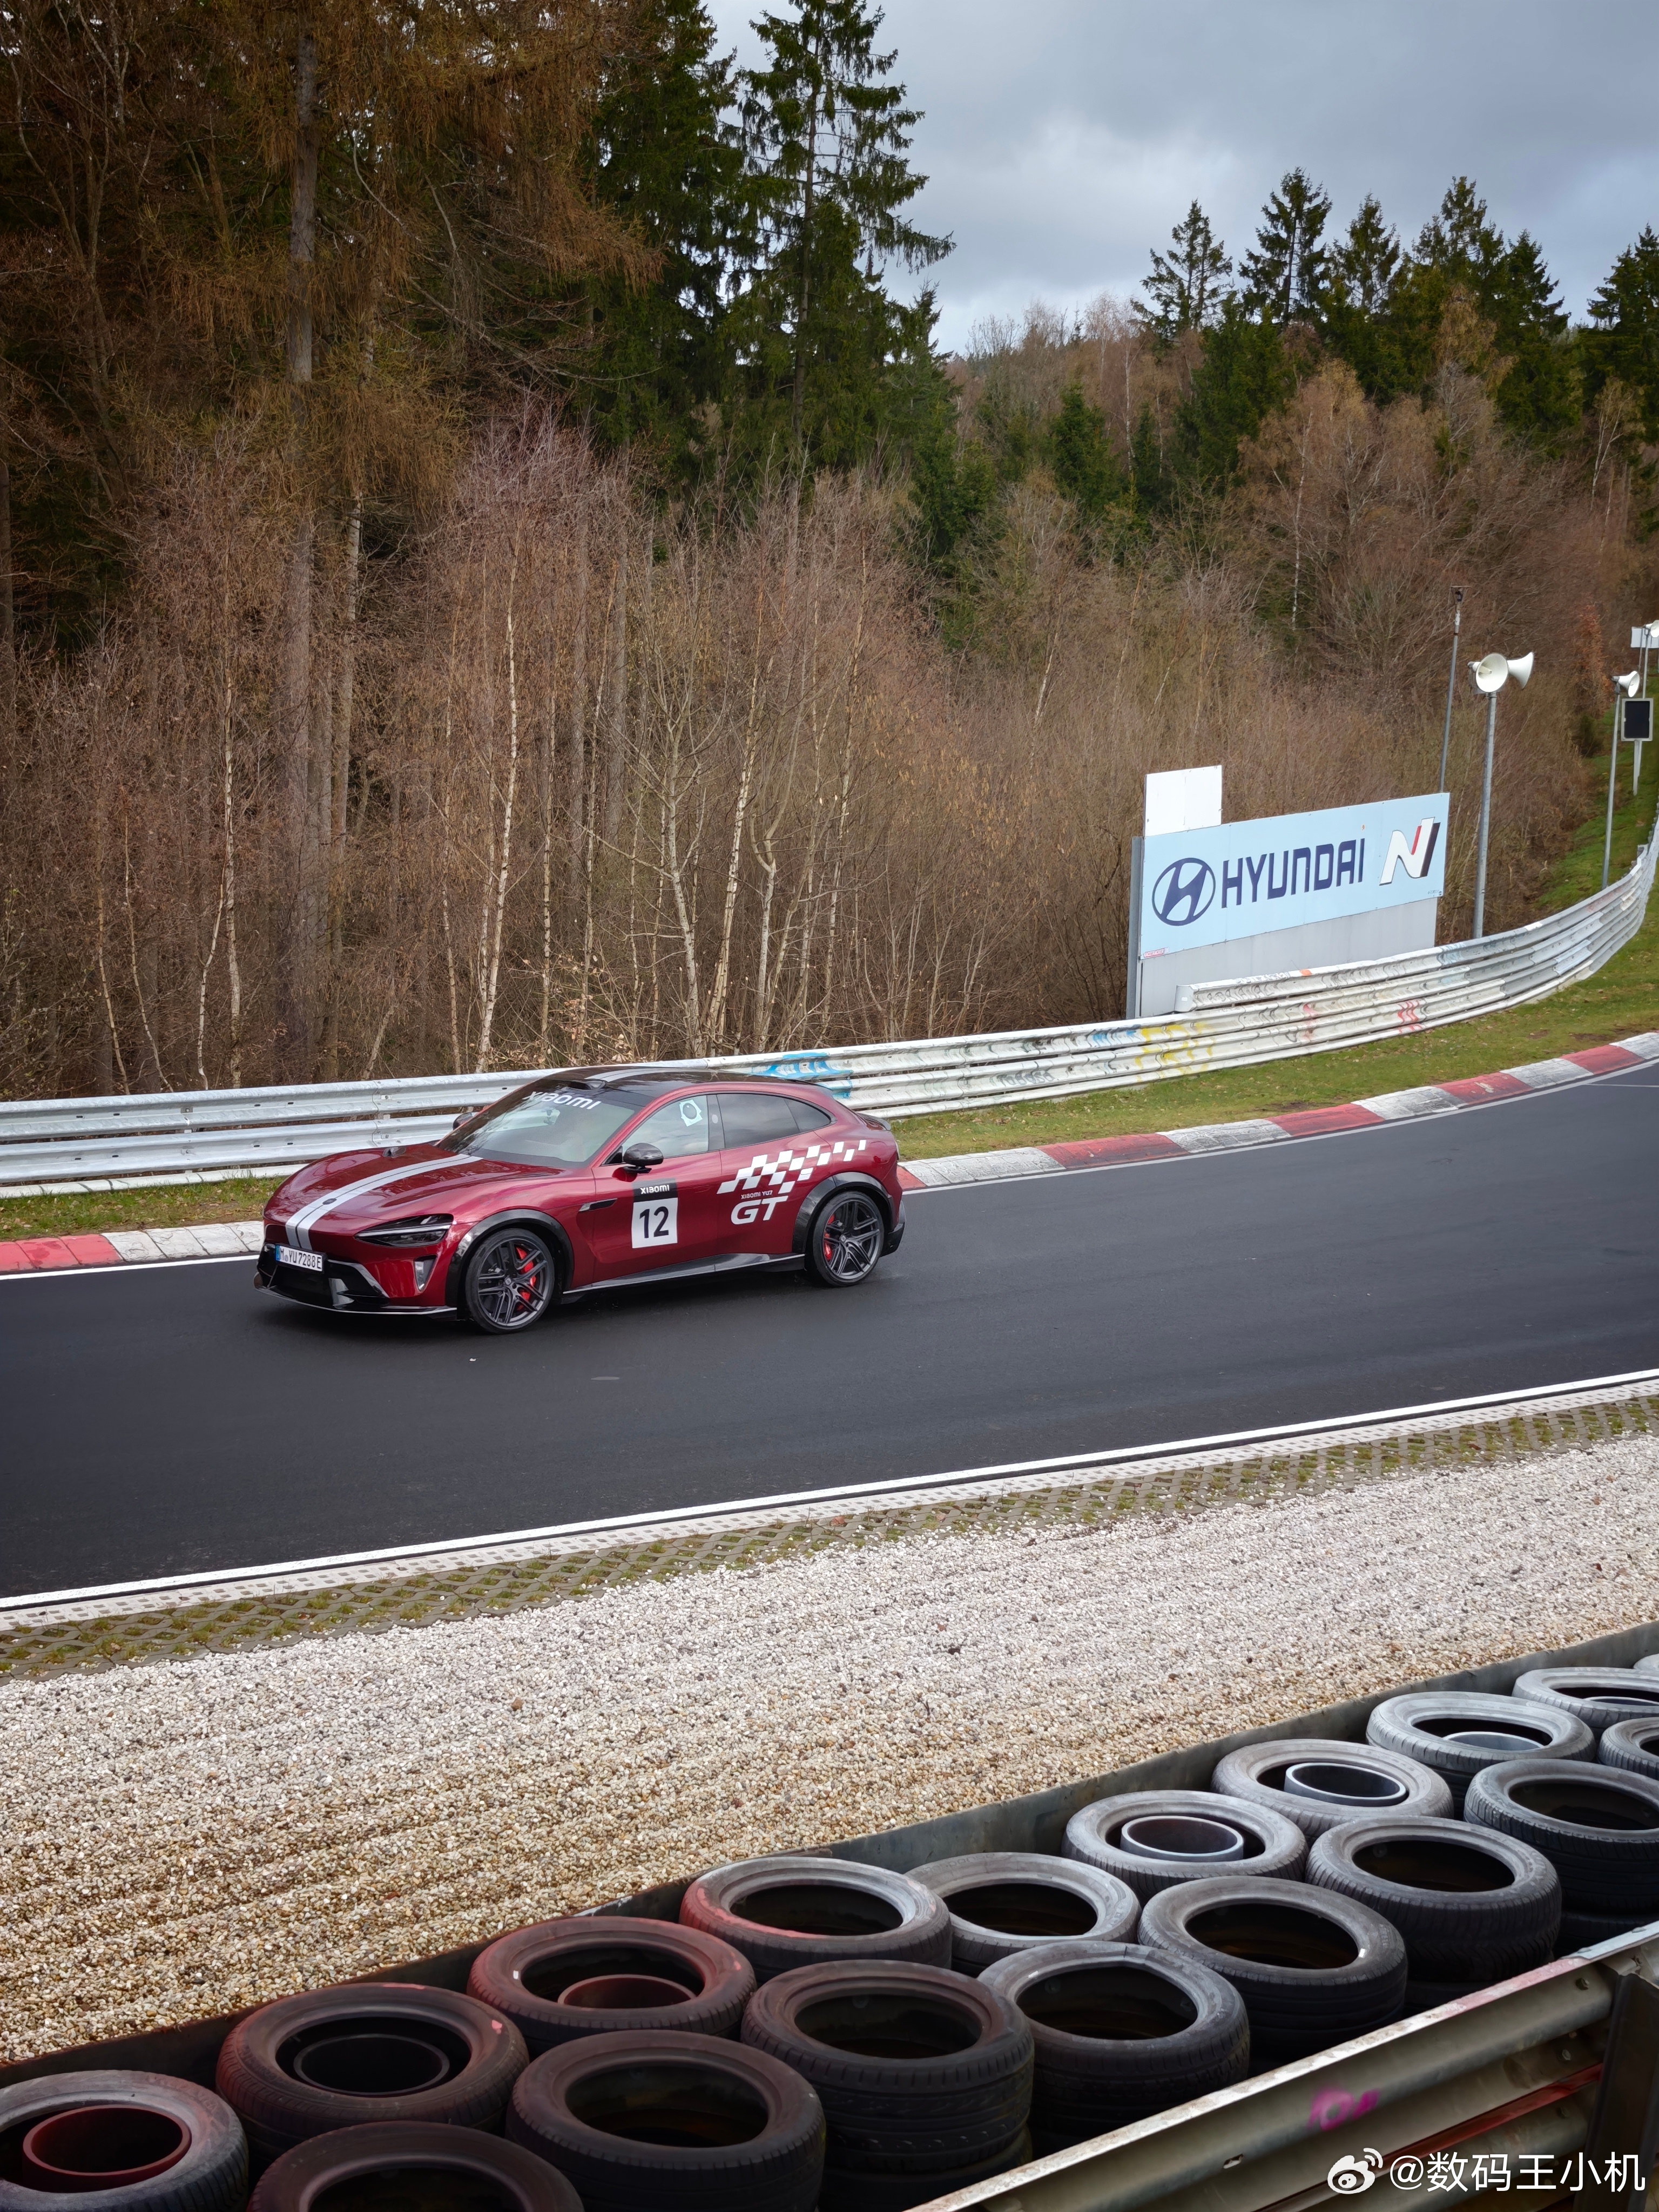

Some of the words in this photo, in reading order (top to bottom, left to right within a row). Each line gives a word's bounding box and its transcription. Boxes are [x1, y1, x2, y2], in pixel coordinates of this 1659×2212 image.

[1221, 838, 1366, 909] HYUNDAI
[639, 1206, 669, 1239] 12
[731, 1195, 789, 1225] GT
